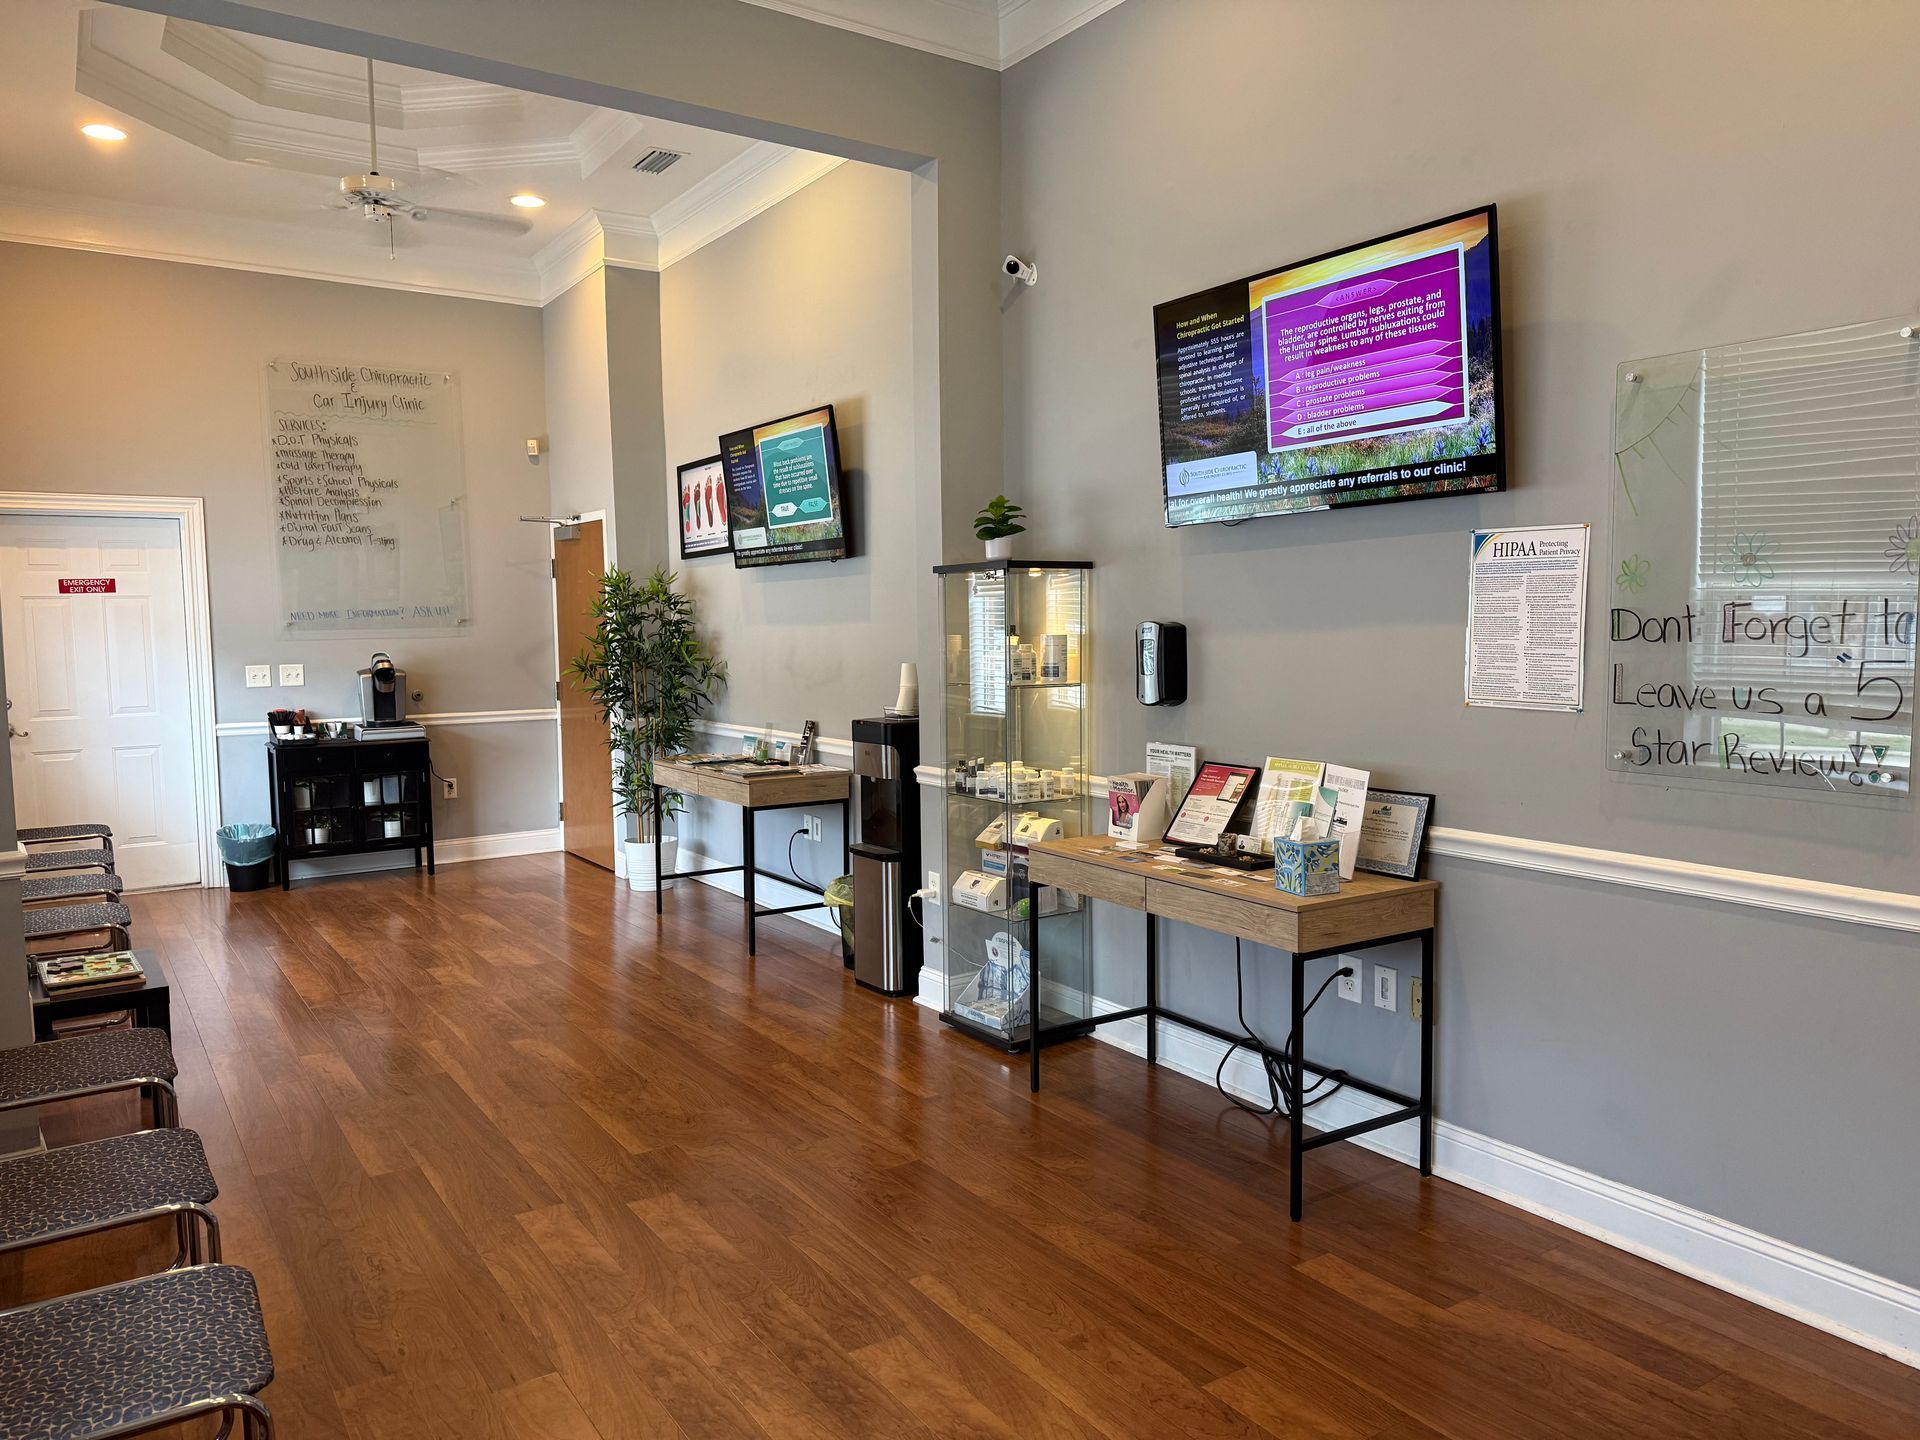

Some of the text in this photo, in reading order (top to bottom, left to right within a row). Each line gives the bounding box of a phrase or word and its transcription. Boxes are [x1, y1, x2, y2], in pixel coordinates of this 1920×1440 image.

[1176, 312, 1217, 329] How and When
[1280, 328, 1293, 336] The
[1295, 317, 1339, 333] reproductive
[1340, 310, 1368, 321] organs,
[1389, 296, 1424, 311] prostate,
[1426, 289, 1442, 300] and
[1177, 315, 1244, 339] Chiropractic Got Started
[1278, 300, 1445, 346] bladder, are controlled by nerves exiting from
[1292, 340, 1316, 351] lumbar
[1318, 336, 1339, 346] spine.
[1342, 328, 1369, 340] Lumbar
[1371, 317, 1420, 333] subluxations
[1423, 308, 1444, 320] could
[1177, 339, 1209, 354] Approximately
[1221, 334, 1234, 342] hours
[1284, 352, 1304, 362] result
[1314, 342, 1348, 355] weakness
[1360, 336, 1373, 344] any
[1375, 332, 1383, 341] of
[1385, 329, 1406, 339] these
[1409, 322, 1438, 333] tissues.
[1178, 352, 1195, 362] devoted
[1203, 346, 1222, 357] learning
[1224, 342, 1238, 350] about
[1199, 355, 1224, 366] techniques
[291, 361, 431, 386] Southside Chiropractic
[1179, 371, 1192, 379] spinal
[1193, 367, 1211, 377] analysis
[1218, 359, 1237, 370] colleges
[1214, 371, 1232, 379] medical
[1316, 359, 1366, 375] pain/weakness
[1199, 383, 1216, 392] training
[1224, 377, 1243, 386] become
[1306, 378, 1346, 392] reproductive
[1348, 371, 1380, 383] problems
[313, 392, 425, 417] Car Injury Clinic
[1180, 394, 1200, 405] proficient
[1208, 387, 1238, 399] manipulation
[1306, 394, 1332, 407] prostate
[1334, 388, 1365, 400] problems
[1181, 404, 1200, 414] generally
[1211, 397, 1230, 408] required
[1307, 408, 1331, 419] bladder
[1333, 403, 1364, 415] problems
[279, 419, 326, 432] SERVICES:
[1316, 423, 1323, 432] of
[1324, 422, 1334, 430] the
[1337, 420, 1356, 428] above
[312, 433, 358, 448] Physicals
[322, 450, 355, 464] Therapy
[326, 462, 363, 476] Therapy
[283, 475, 313, 489] Sports
[358, 476, 399, 492] Physicals
[1178, 498, 1190, 506] for
[1191, 495, 1214, 505] overall
[1216, 490, 1243, 501] health!
[1245, 490, 1257, 498] We
[1260, 486, 1287, 499] greatly
[1290, 479, 1335, 494] appreciate
[1338, 477, 1354, 487] any
[1358, 470, 1398, 484] referrals
[1400, 469, 1411, 479] to
[1414, 467, 1431, 477] our
[1434, 461, 1466, 475] clinic!
[325, 488, 360, 499] Analysis
[284, 496, 313, 510] Spinal
[285, 508, 359, 523] Nutrition Plans
[289, 535, 362, 552] Drug Alcohol
[1493, 541, 1537, 557] HIPAA
[290, 610, 315, 621] NEED
[413, 606, 432, 618] ASK
[1611, 598, 1915, 657] Dont Forget to
[1613, 660, 1907, 721] Leave us a 5
[1630, 727, 1712, 766] Star
